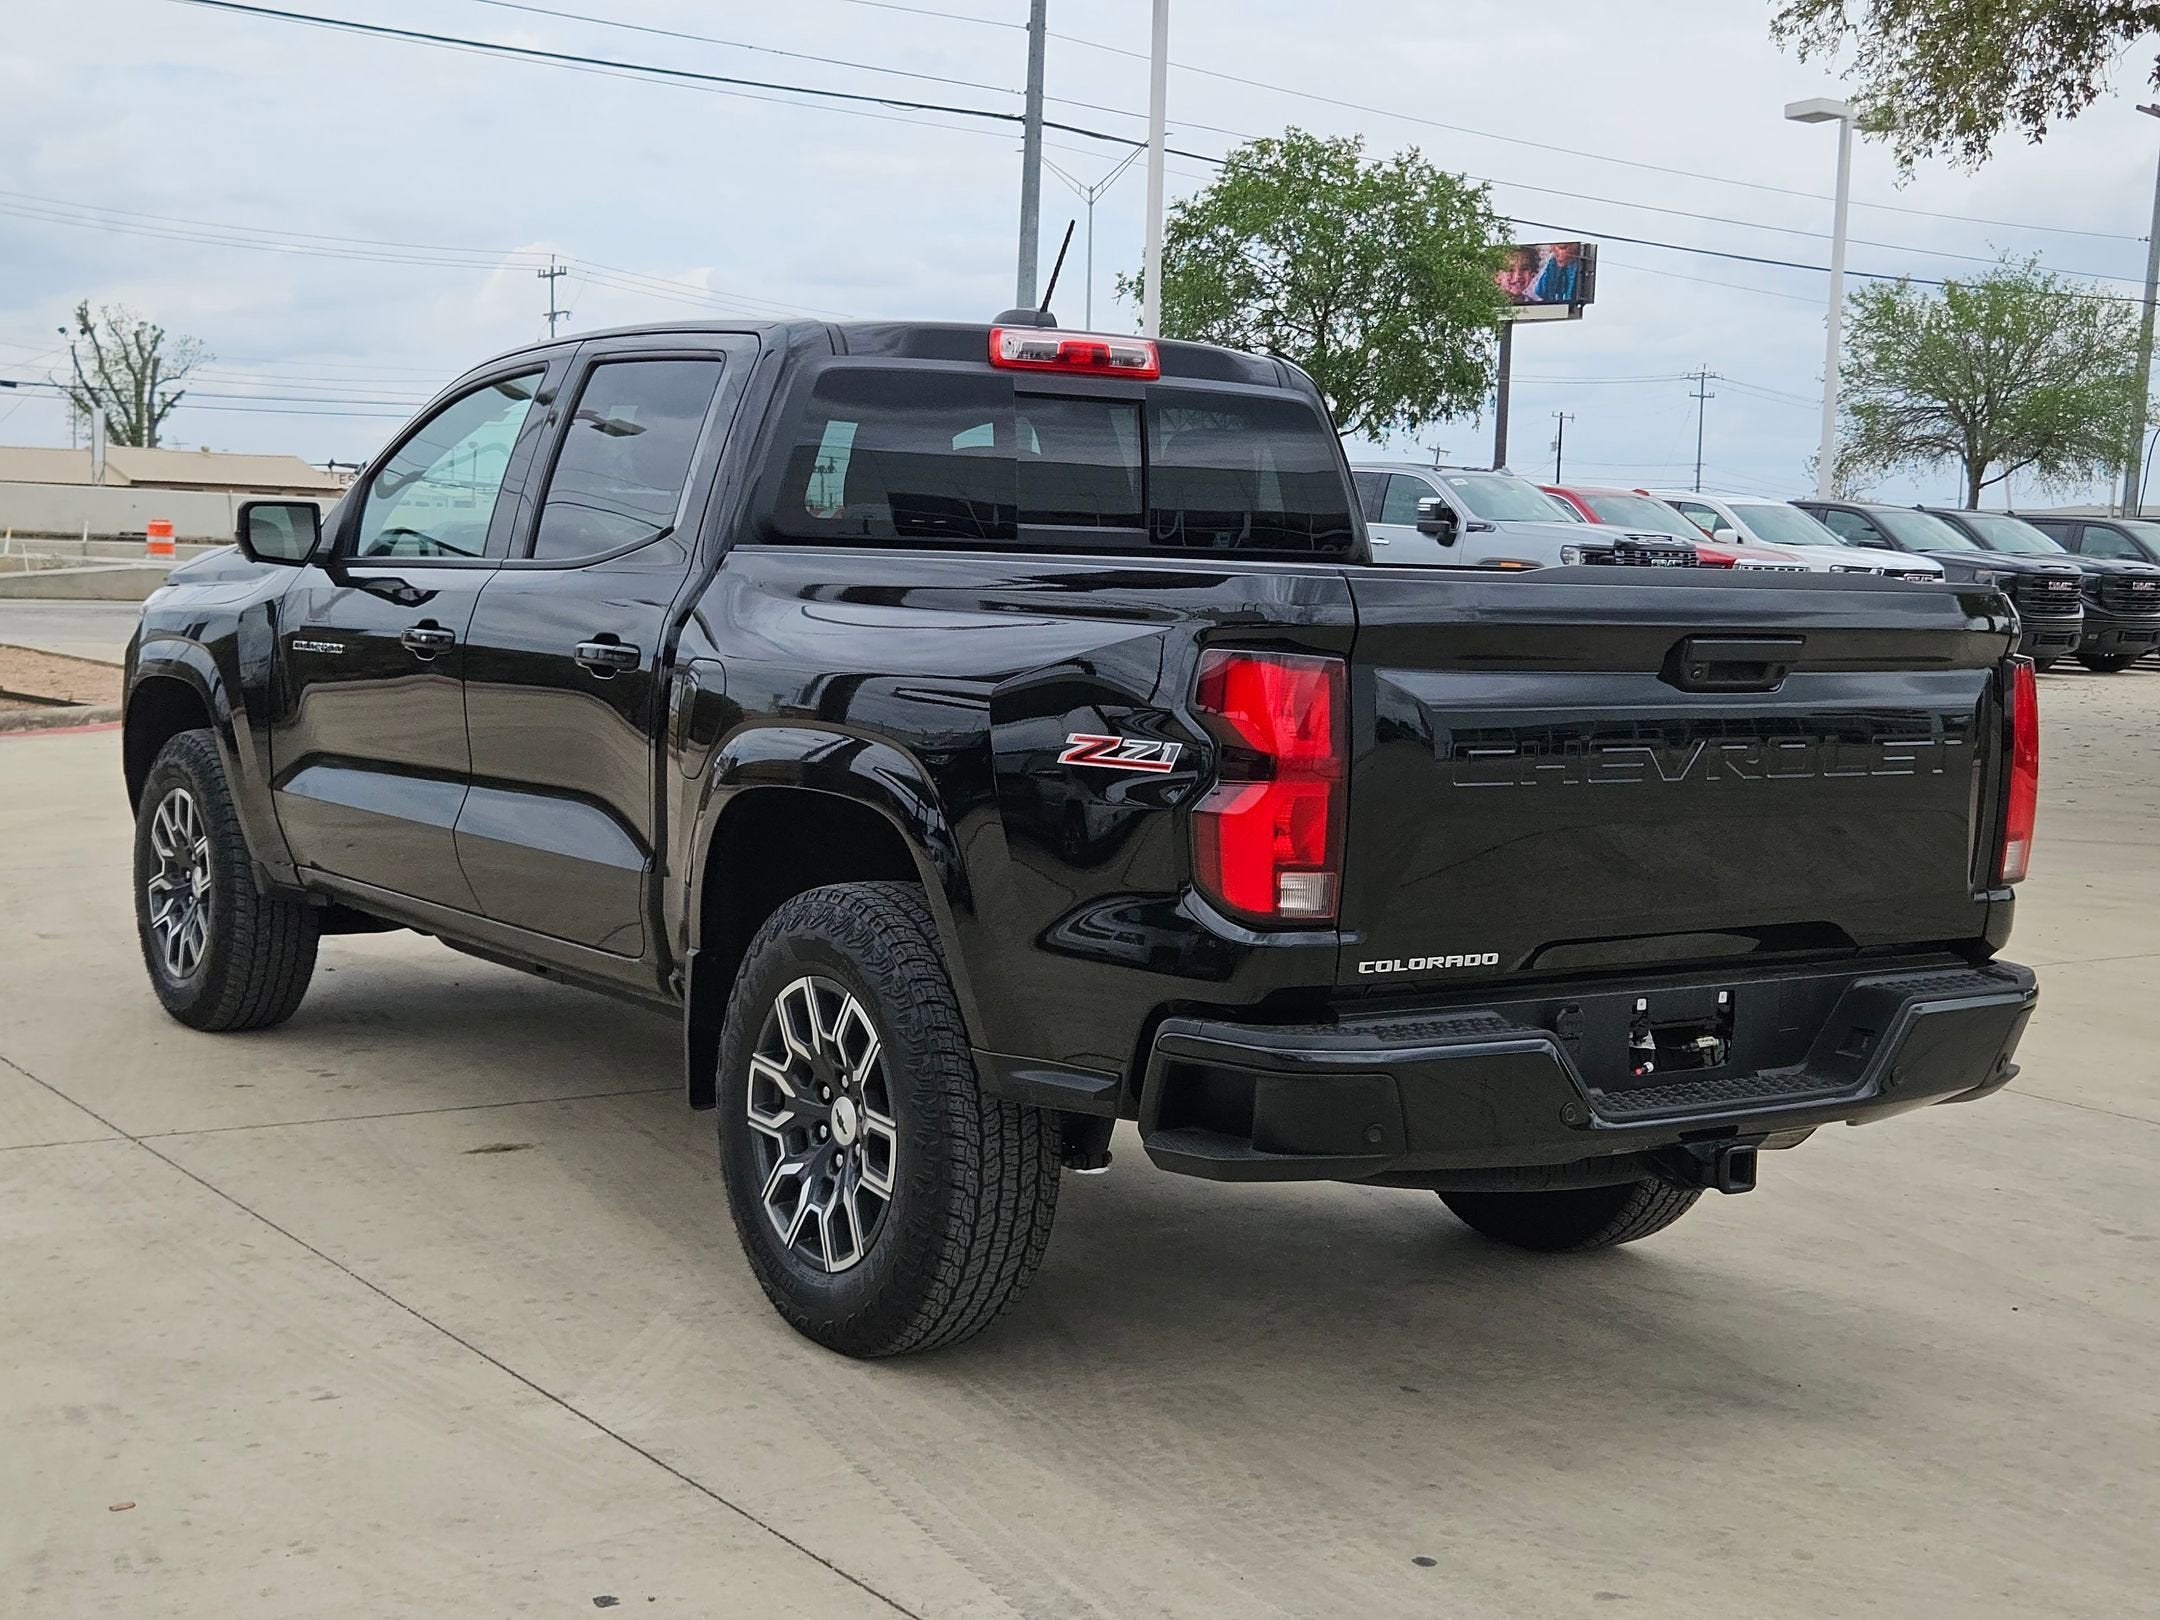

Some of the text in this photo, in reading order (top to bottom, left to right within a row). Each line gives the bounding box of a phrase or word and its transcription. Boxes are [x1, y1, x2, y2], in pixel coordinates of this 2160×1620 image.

[1057, 733, 1183, 773] Z71
[1452, 735, 1963, 787] CHEVROLET
[1358, 952, 1500, 974] COLORADO
